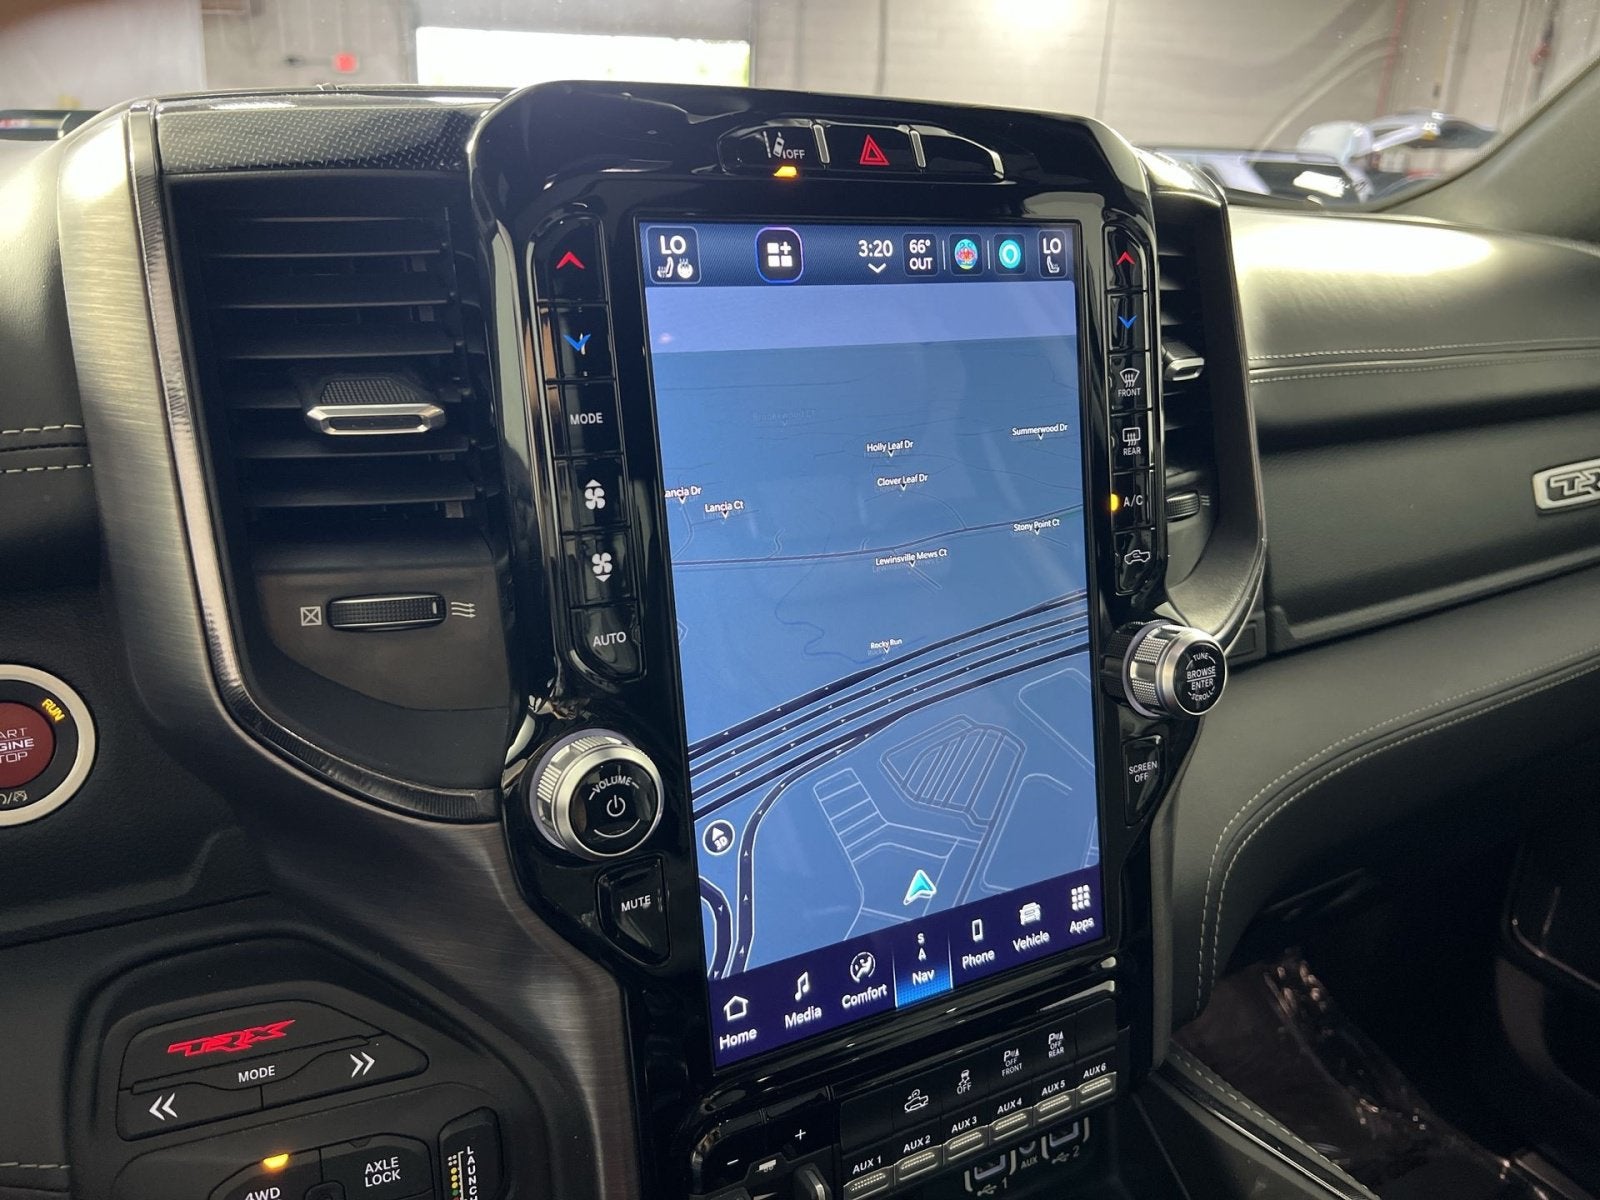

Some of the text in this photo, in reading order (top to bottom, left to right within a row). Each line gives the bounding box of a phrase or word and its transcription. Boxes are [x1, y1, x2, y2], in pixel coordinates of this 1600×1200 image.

[785, 148, 806, 160] OFF
[659, 234, 687, 255] LO
[858, 239, 893, 258] 3:20
[1042, 237, 1062, 255] LO
[909, 257, 933, 270] OUT
[1117, 387, 1142, 398] FRONT
[569, 412, 604, 426] MODE
[1011, 423, 1068, 436] Summerwood Dr
[866, 440, 914, 453] Holly Leaf Dr
[1123, 446, 1142, 456] REAR
[877, 474, 928, 487] Clover Leaf Dr
[690, 485, 702, 496] Dr
[704, 500, 744, 514] Lancia Ct
[1123, 494, 1144, 508] A/C
[1013, 518, 1060, 533] Stony Point Ct
[875, 548, 948, 566] Lewinsville Mews Ct
[592, 631, 627, 647] AUTO
[1192, 652, 1209, 662] TUNE
[1186, 665, 1217, 680] BROWSE
[1190, 679, 1215, 691] ENTER
[1190, 690, 1214, 702] SCROLL
[41, 698, 66, 723] RUN
[1128, 760, 1158, 775] SCREEN
[592, 775, 633, 794] VOLUME
[1134, 772, 1150, 783] OFF
[713, 835, 729, 851] 3D
[620, 894, 652, 912] MUTE
[1069, 917, 1095, 935] Apps
[1012, 930, 1051, 953] Vehicle
[961, 949, 996, 970] Phone
[912, 969, 935, 986] Nav
[841, 983, 888, 1009] Comfort
[784, 1005, 823, 1029] Media
[167, 1019, 297, 1057] TRX
[719, 1027, 758, 1051] Home
[1049, 1040, 1063, 1050] OFF
[1048, 1047, 1065, 1059] REAR
[1001, 1062, 1023, 1077] FRONT
[1005, 1058, 1018, 1068] OFF
[1082, 1062, 1107, 1079] AUX 6
[238, 1065, 276, 1083] MODE
[956, 1082, 972, 1095] OFF
[1041, 1079, 1066, 1097] AUX 5
[996, 1097, 1023, 1115] AUX 4
[951, 1115, 978, 1134] AUX 3
[903, 1134, 931, 1154] AUX 2
[364, 1156, 399, 1175] AXLE
[852, 1155, 883, 1175] AUX 1
[1020, 1155, 1038, 1170] AUX
[364, 1169, 401, 1188] LOCK
